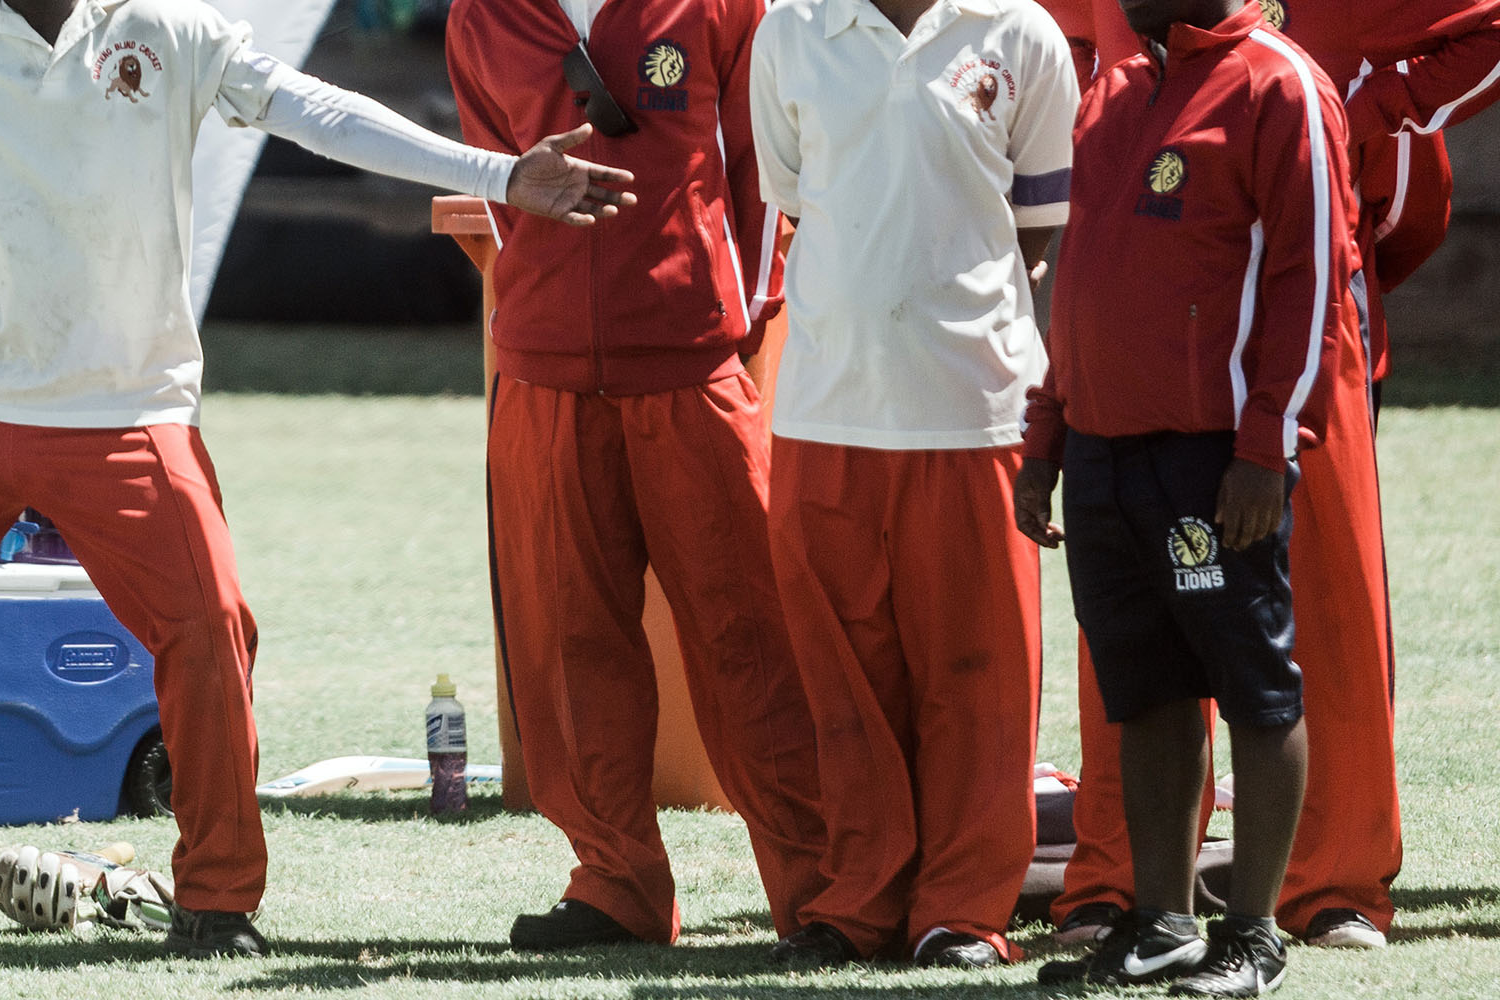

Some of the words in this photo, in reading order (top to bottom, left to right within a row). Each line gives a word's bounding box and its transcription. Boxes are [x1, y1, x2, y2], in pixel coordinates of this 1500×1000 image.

[92, 48, 113, 80] GAUTENG
[114, 40, 136, 51] BLIND
[139, 44, 163, 71] CRICKET
[949, 61, 976, 87] GAUTENG
[979, 58, 1001, 70] BLIND
[1002, 69, 1016, 101] CRICKET
[1176, 570, 1225, 591] LIONS
